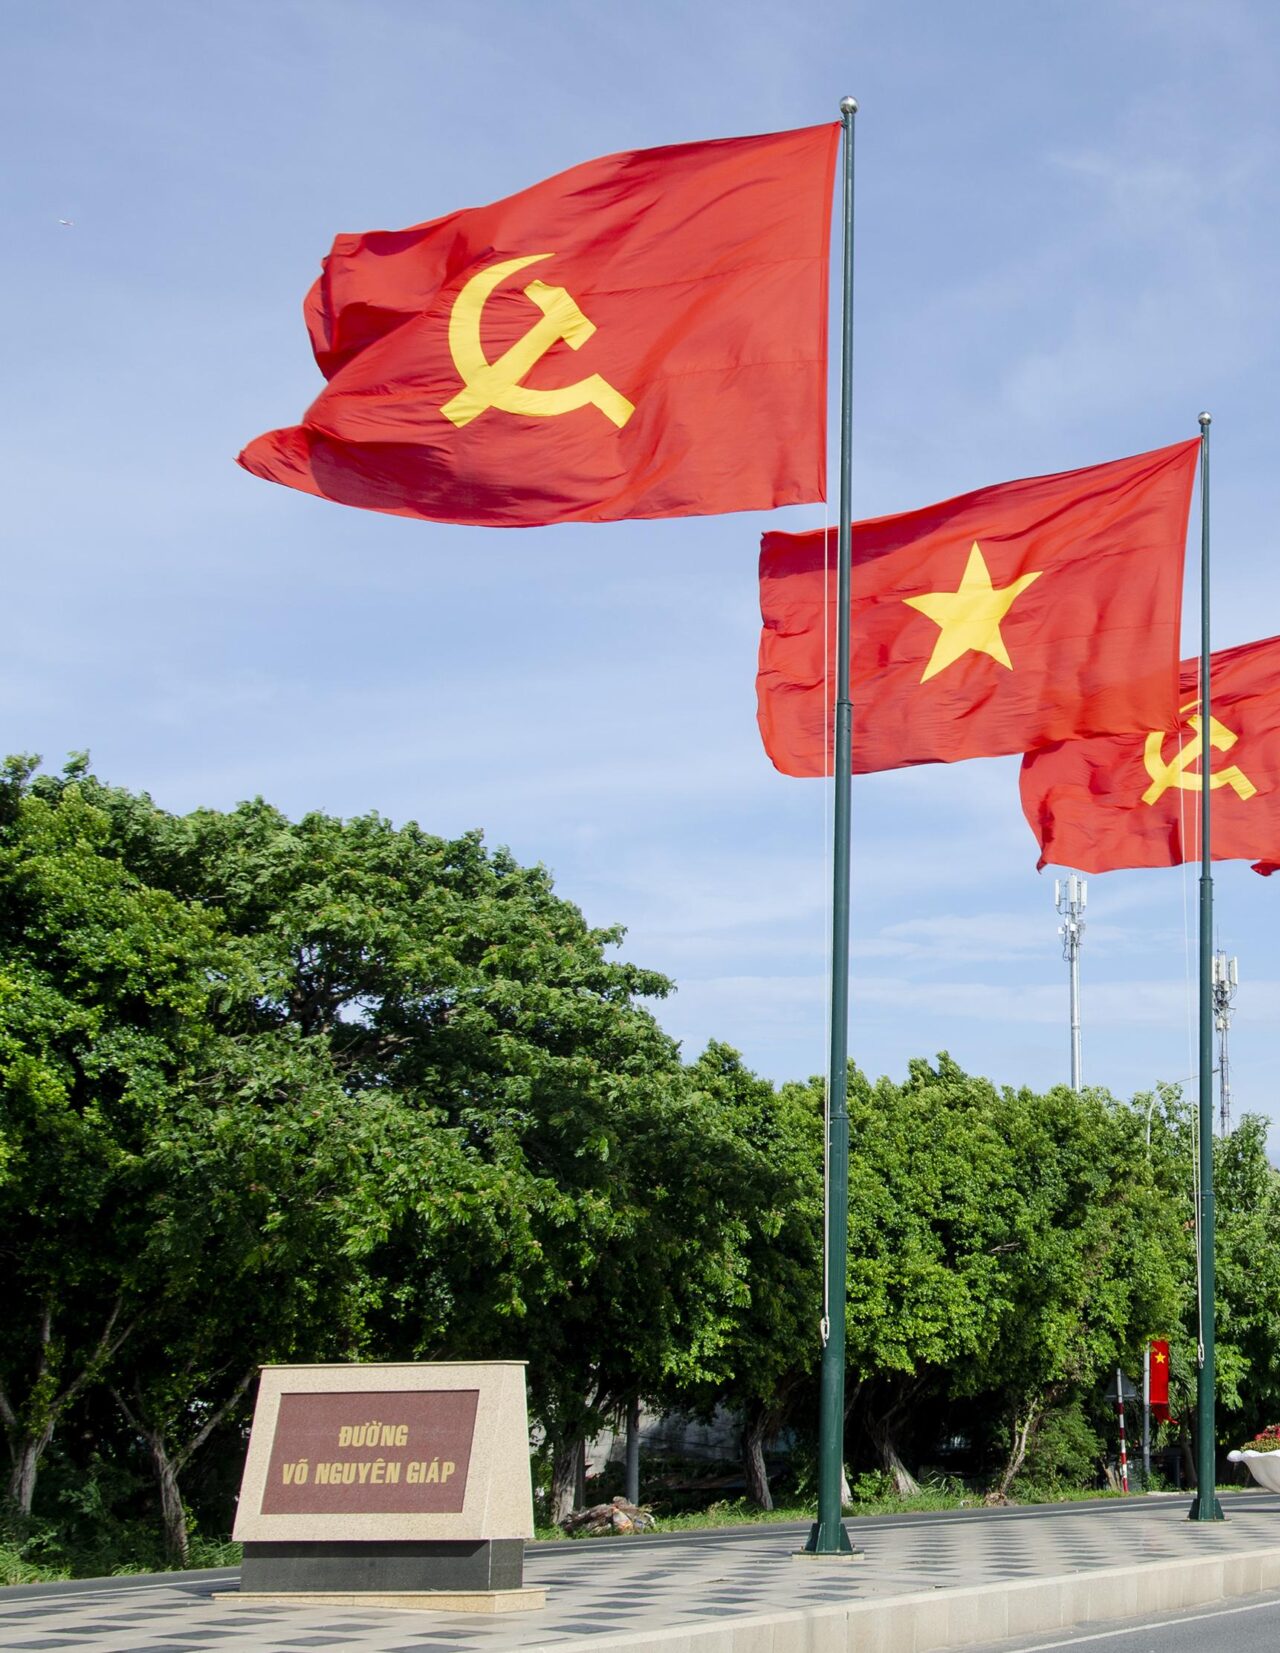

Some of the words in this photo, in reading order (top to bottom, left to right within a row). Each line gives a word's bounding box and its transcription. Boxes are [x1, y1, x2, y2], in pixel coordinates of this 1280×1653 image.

[338, 1420, 409, 1447] ĐƯỜNG
[282, 1458, 309, 1485] VÕ
[315, 1457, 402, 1485] NGUYÊN
[406, 1456, 456, 1484] GIÁP
